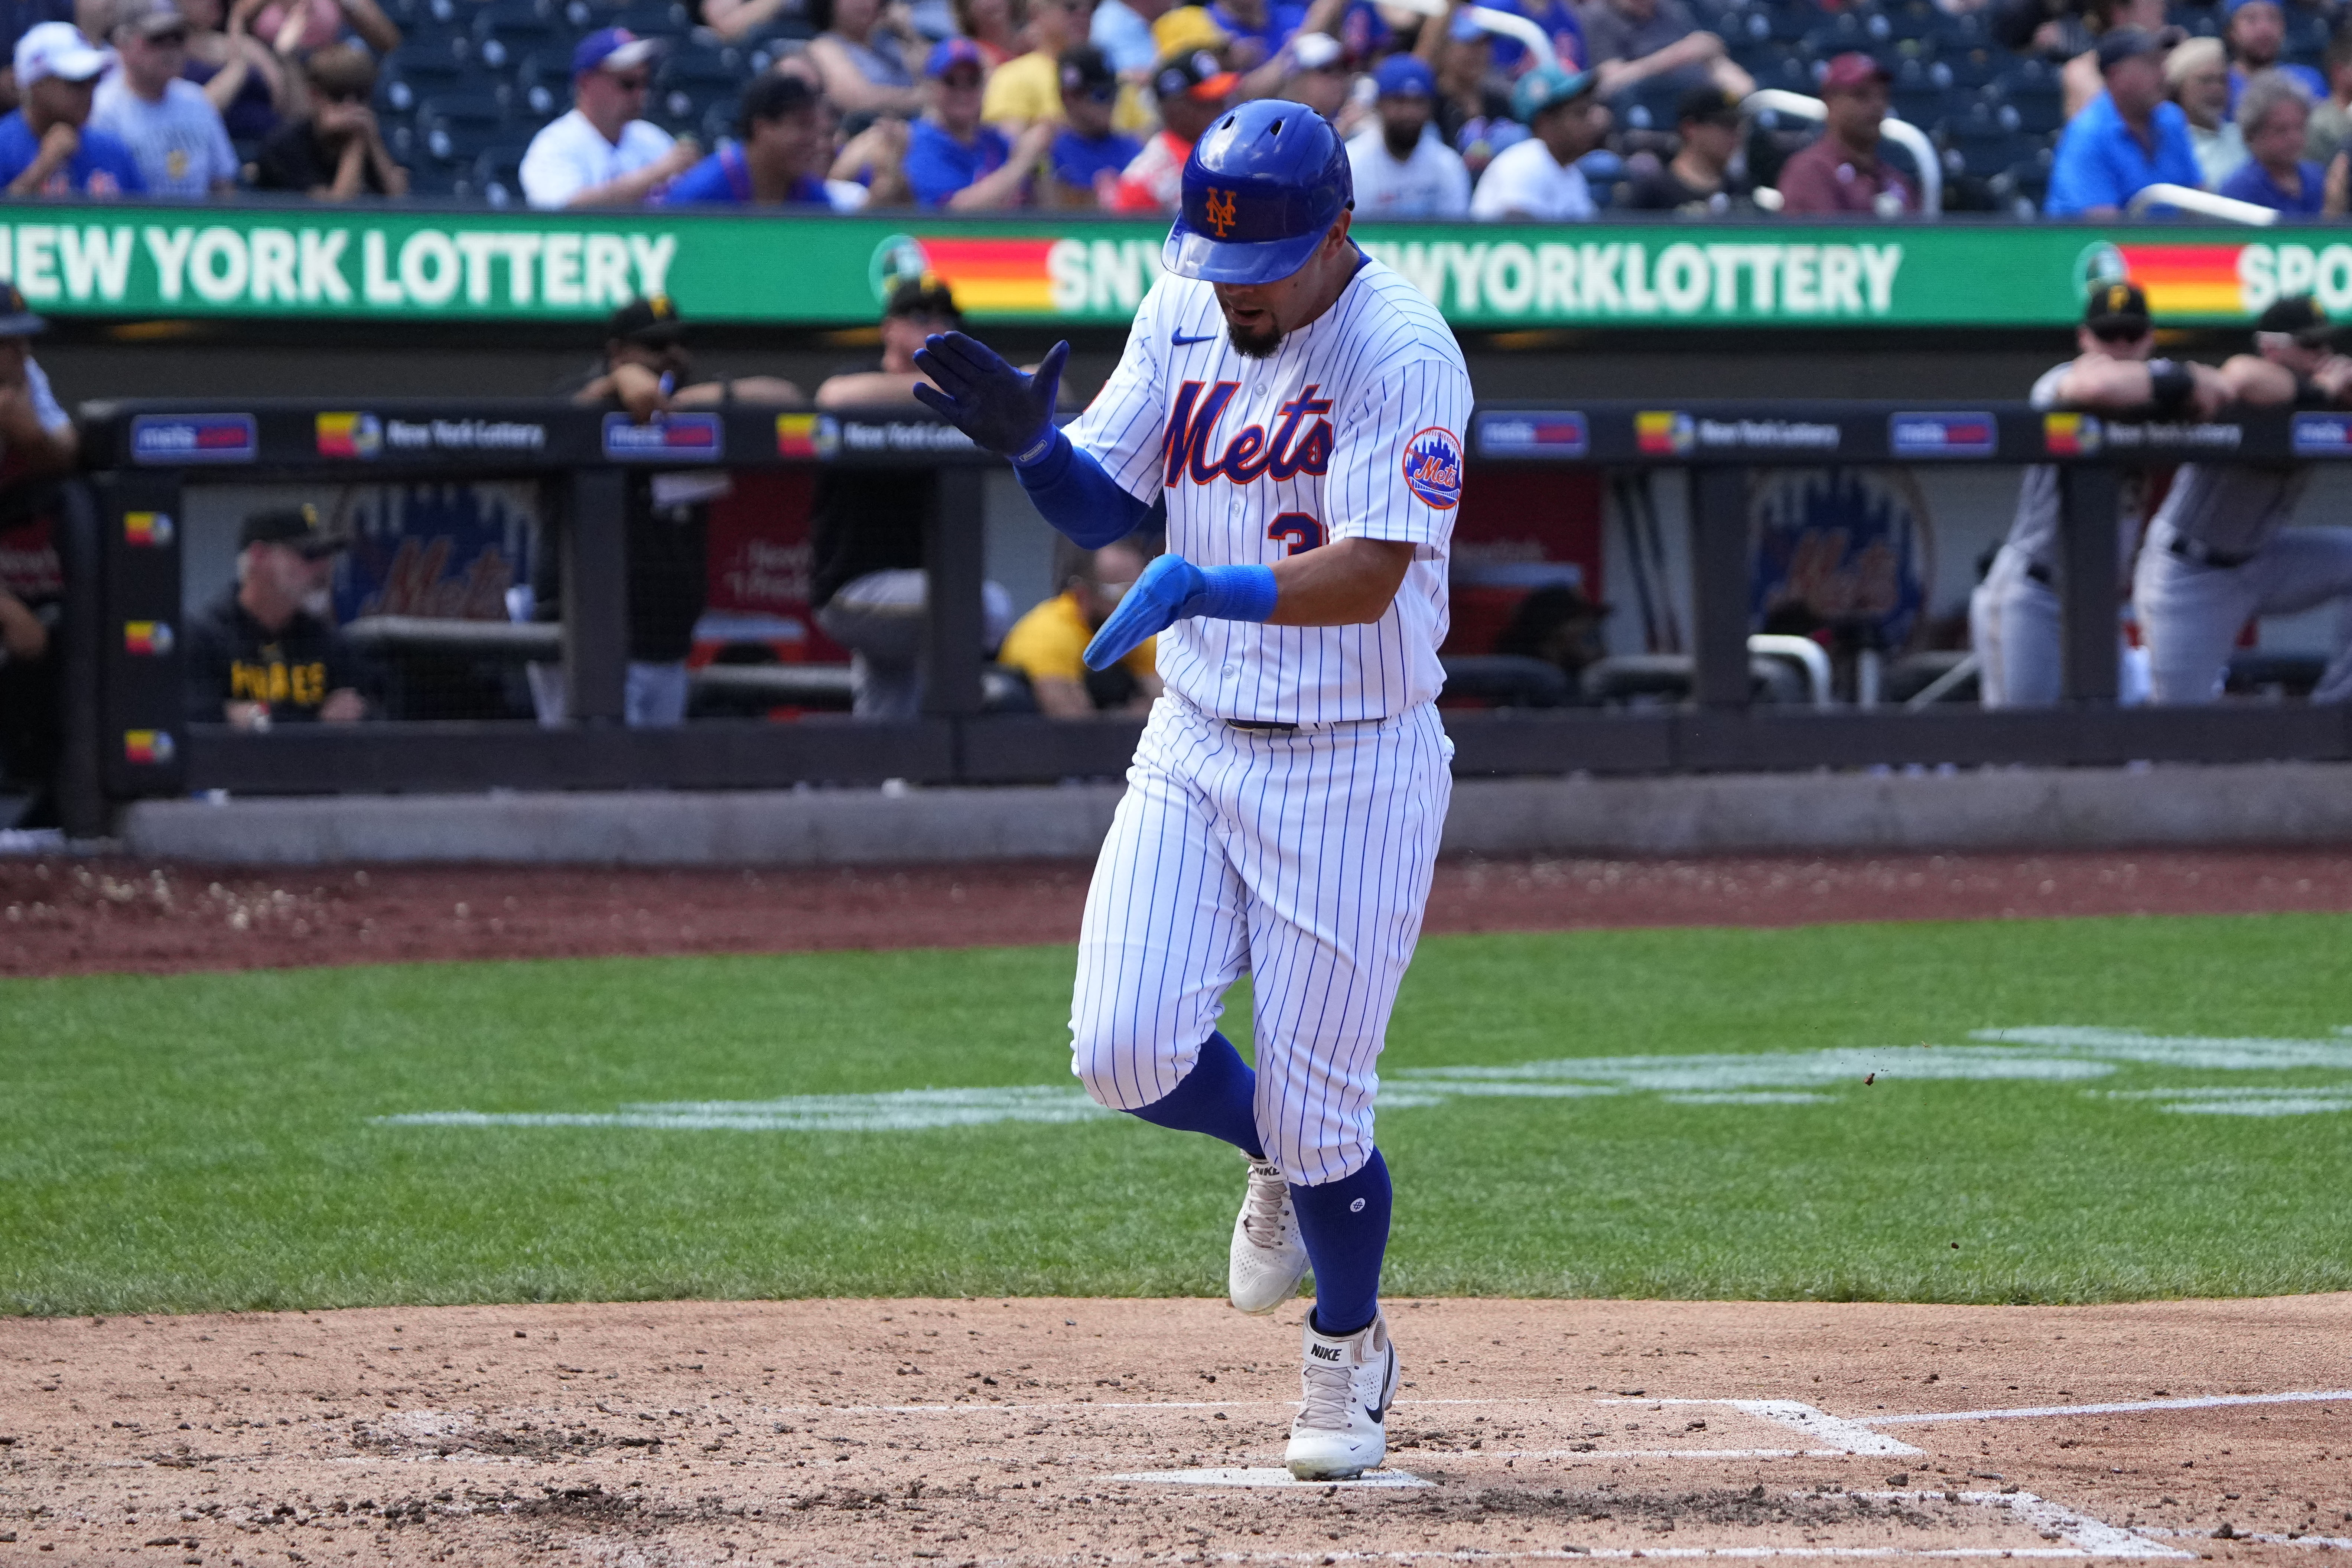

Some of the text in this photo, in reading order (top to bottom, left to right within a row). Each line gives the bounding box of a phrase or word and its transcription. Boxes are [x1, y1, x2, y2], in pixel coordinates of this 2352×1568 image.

[0, 224, 677, 305] EW YORK LOTTERY
[1162, 380, 1333, 488] Mets
[1413, 455, 1457, 488] Mets
[1310, 1343, 1342, 1361] NIKE
